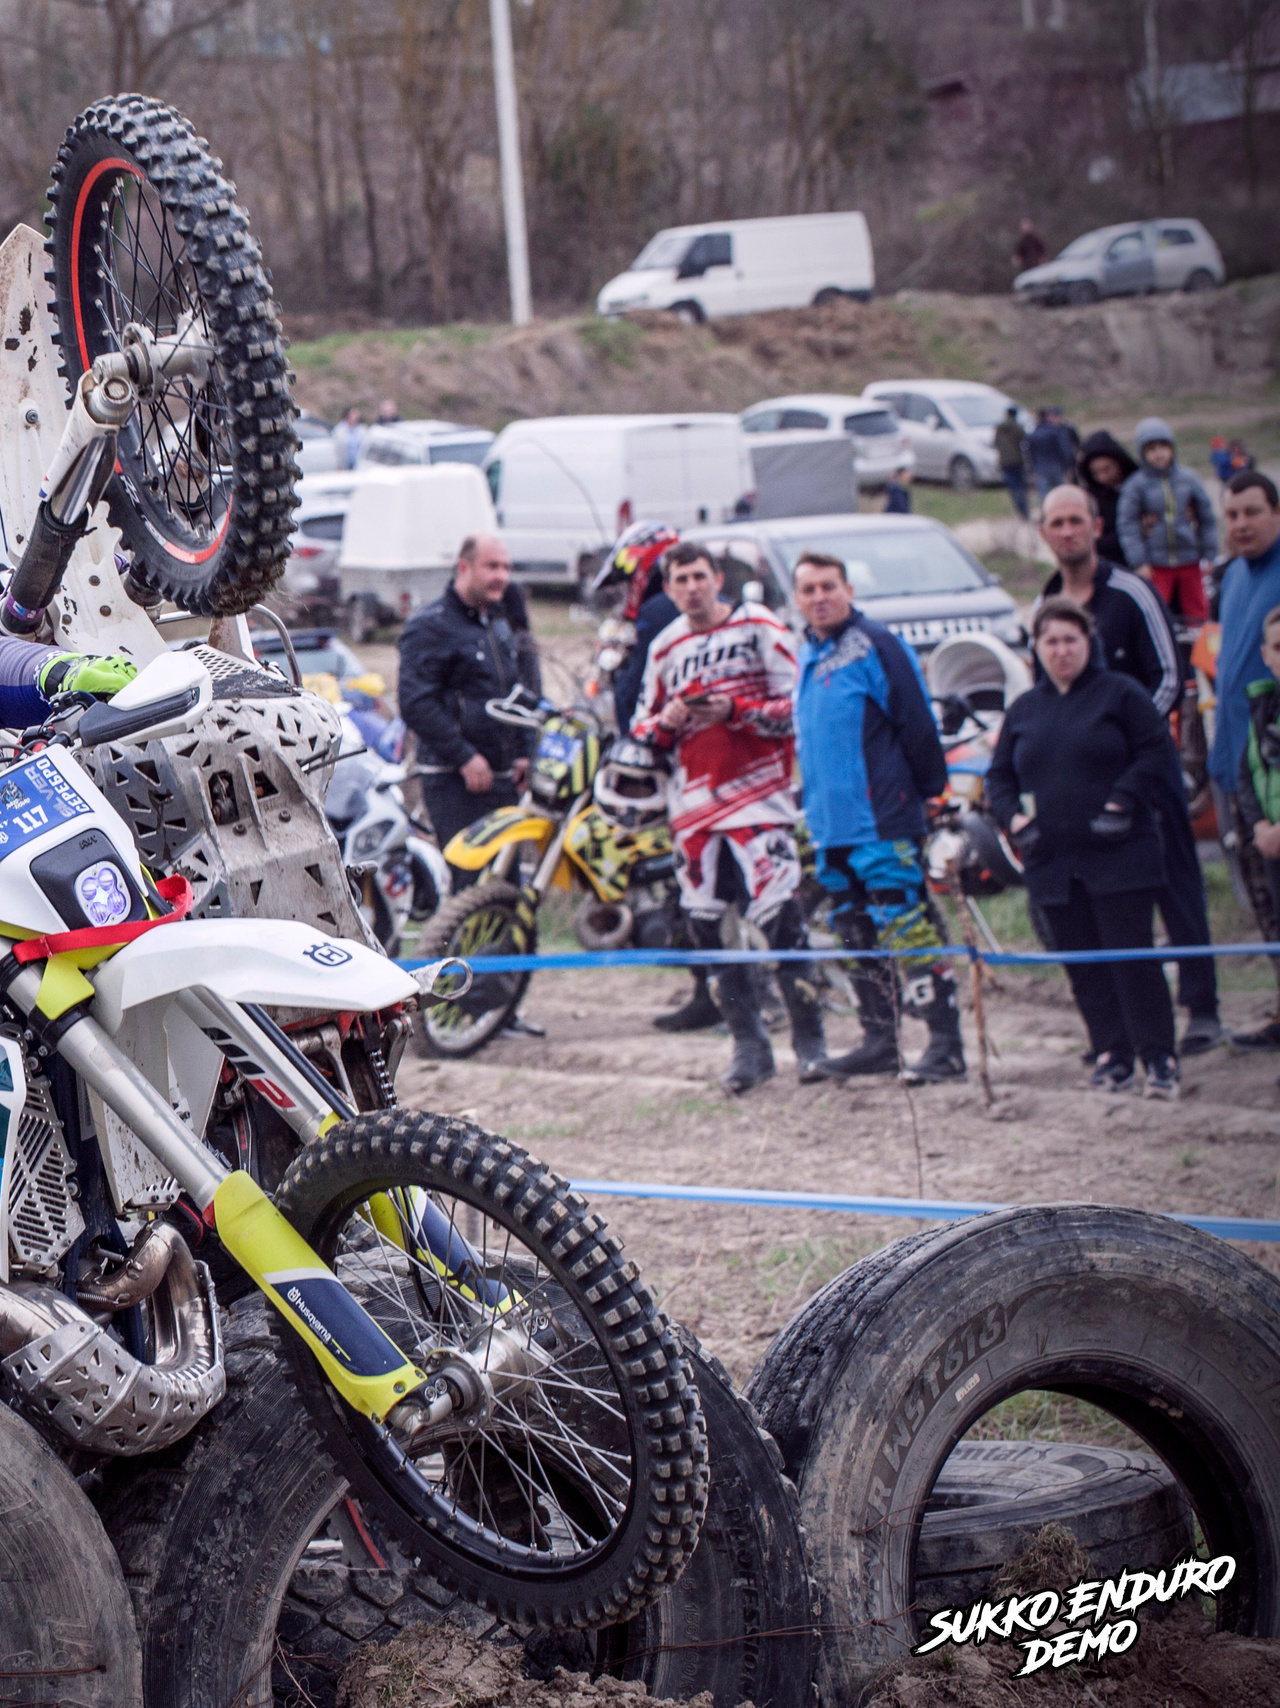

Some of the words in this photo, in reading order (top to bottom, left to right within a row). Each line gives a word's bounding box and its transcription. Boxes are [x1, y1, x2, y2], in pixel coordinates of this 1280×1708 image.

[36, 758, 89, 813] СЕРЕБРО
[12, 804, 49, 835] 117
[295, 1296, 332, 1342] Husqvarna
